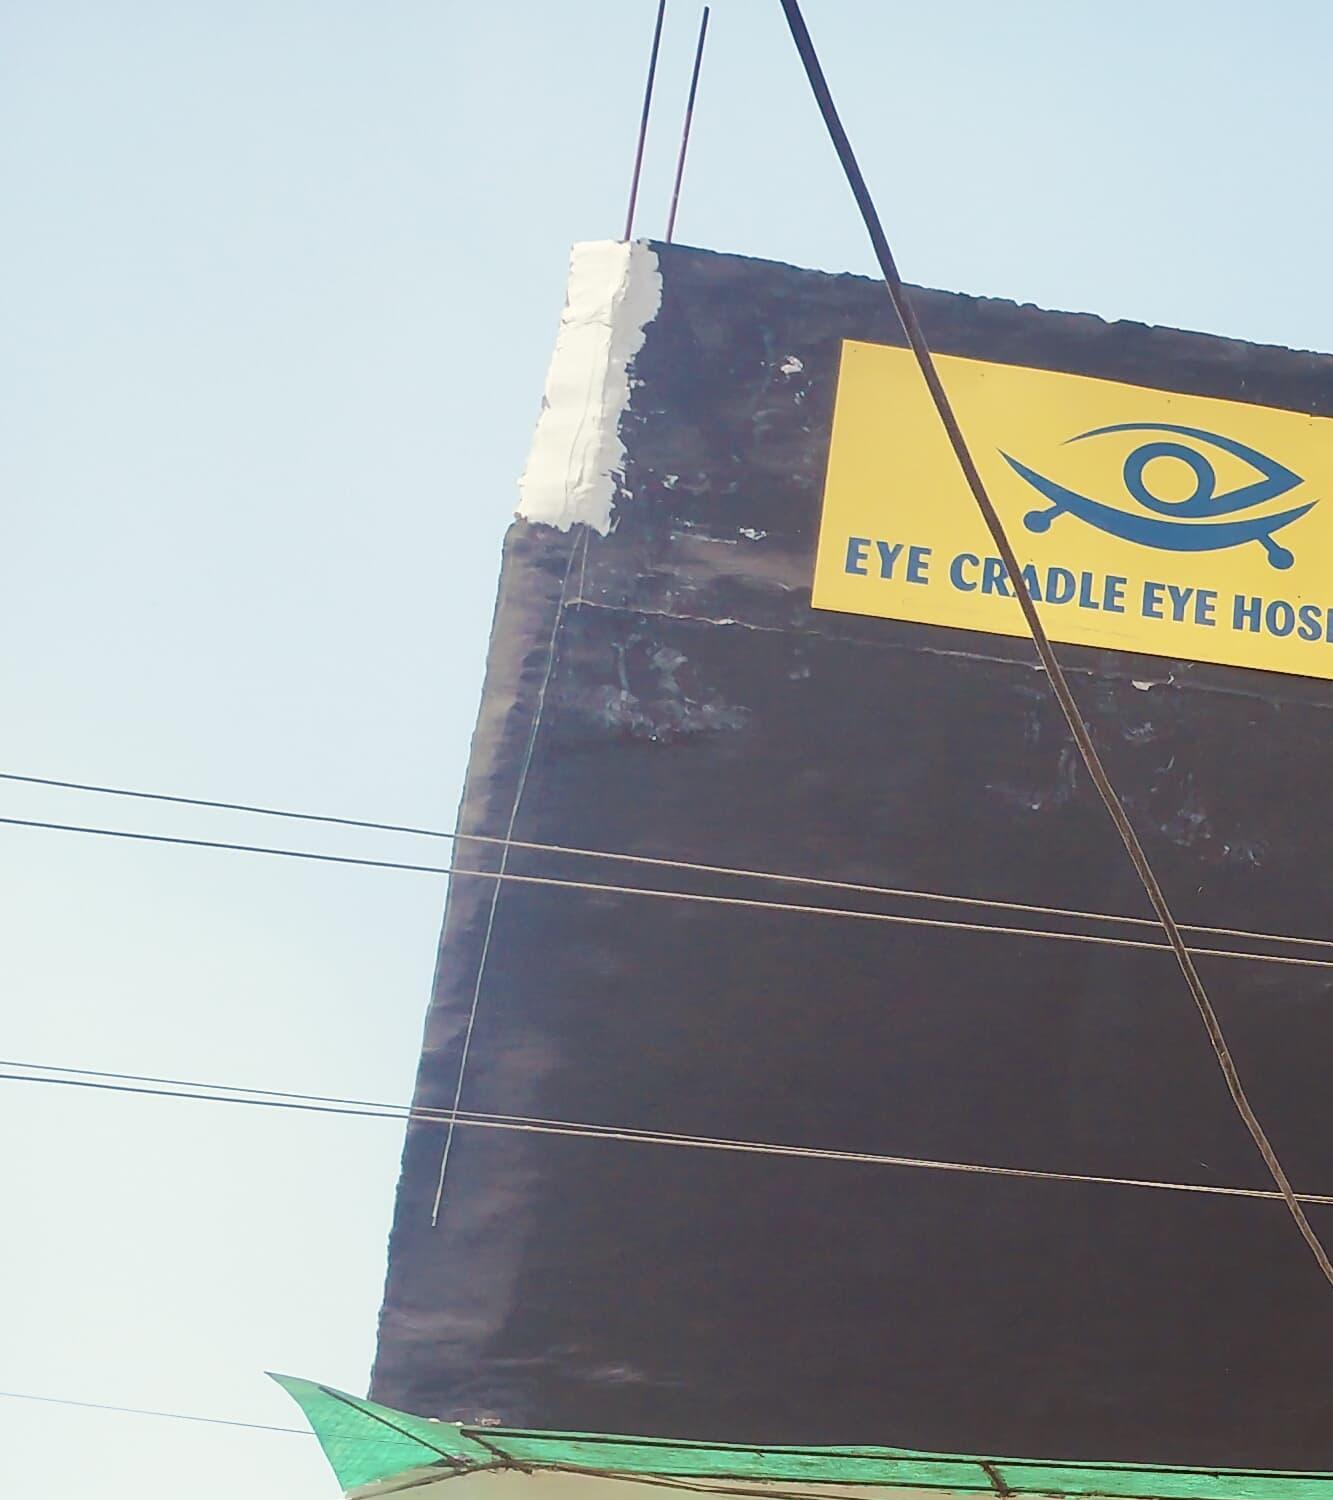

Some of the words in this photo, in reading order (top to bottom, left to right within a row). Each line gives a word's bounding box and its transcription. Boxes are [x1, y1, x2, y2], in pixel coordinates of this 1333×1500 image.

[845, 537, 932, 584] EYE
[950, 553, 1126, 614] CRADLE
[1142, 582, 1218, 627] EYE
